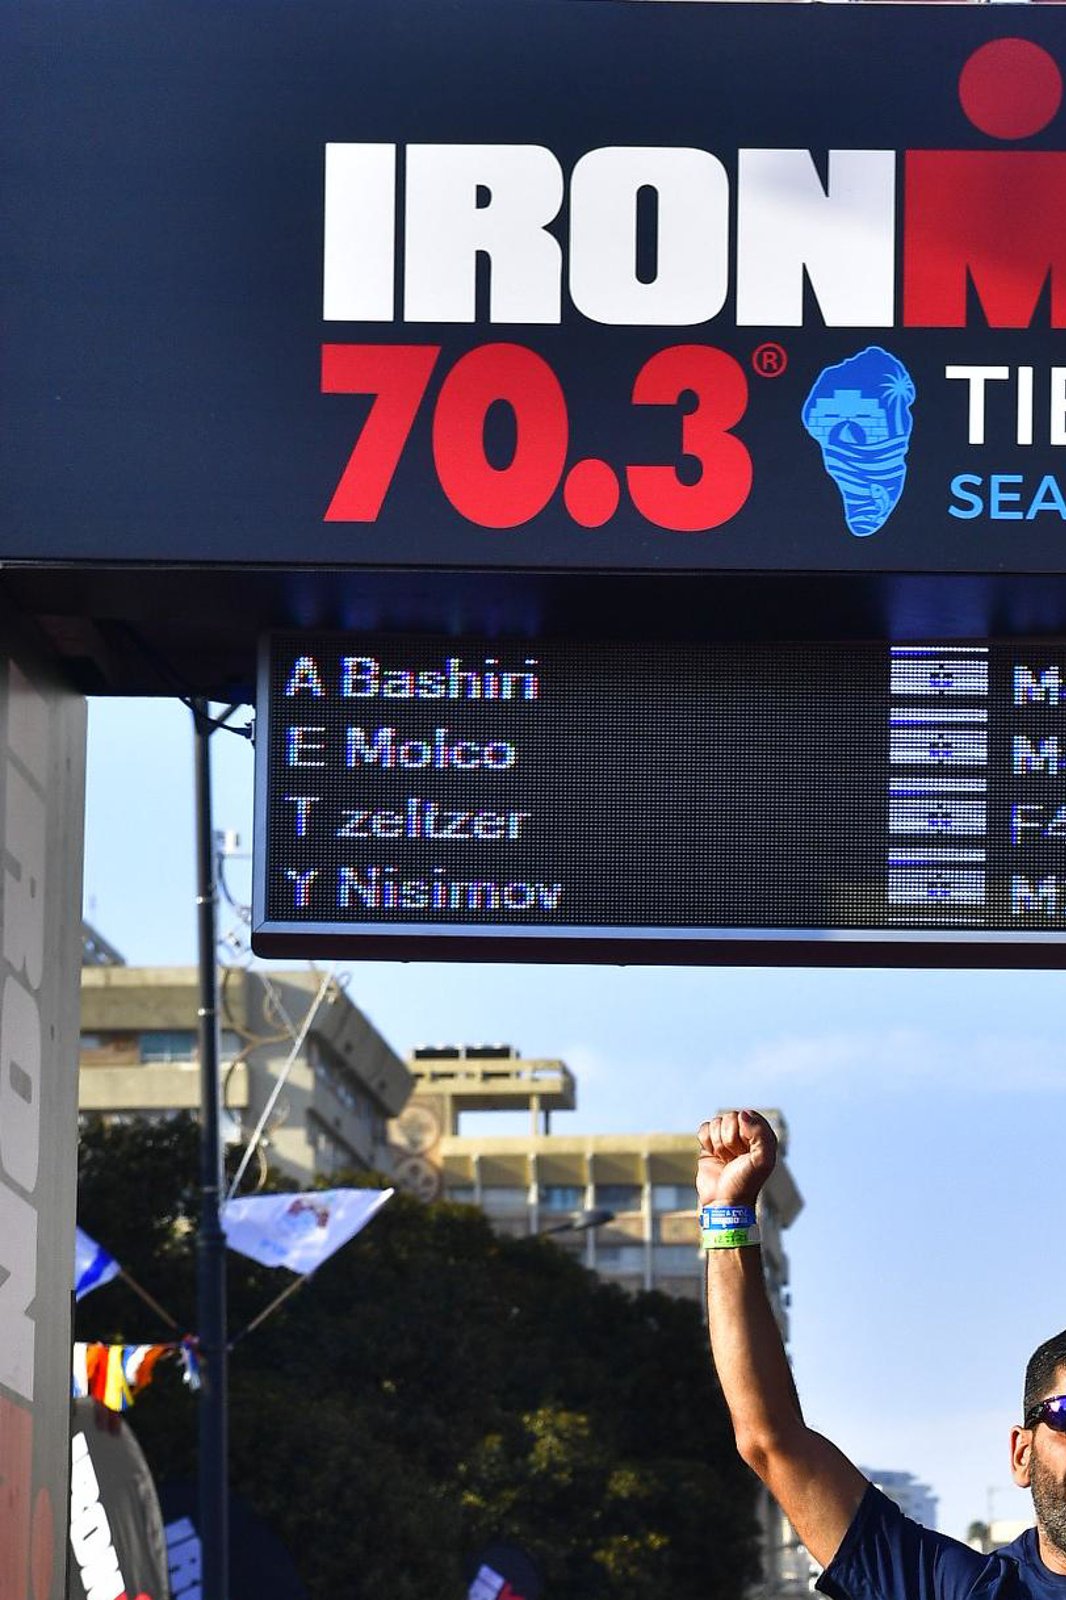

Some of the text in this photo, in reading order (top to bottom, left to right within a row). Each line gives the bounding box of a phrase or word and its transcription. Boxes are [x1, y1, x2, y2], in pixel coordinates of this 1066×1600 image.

[321, 342, 754, 531] 70.3
[284, 656, 325, 698] A
[340, 656, 539, 700] Bashiri
[286, 727, 325, 767] E
[346, 727, 516, 769] Molco
[286, 795, 320, 836] T
[337, 797, 531, 839] zeltzer
[286, 867, 318, 906] Y
[338, 866, 562, 909] Nisimov
